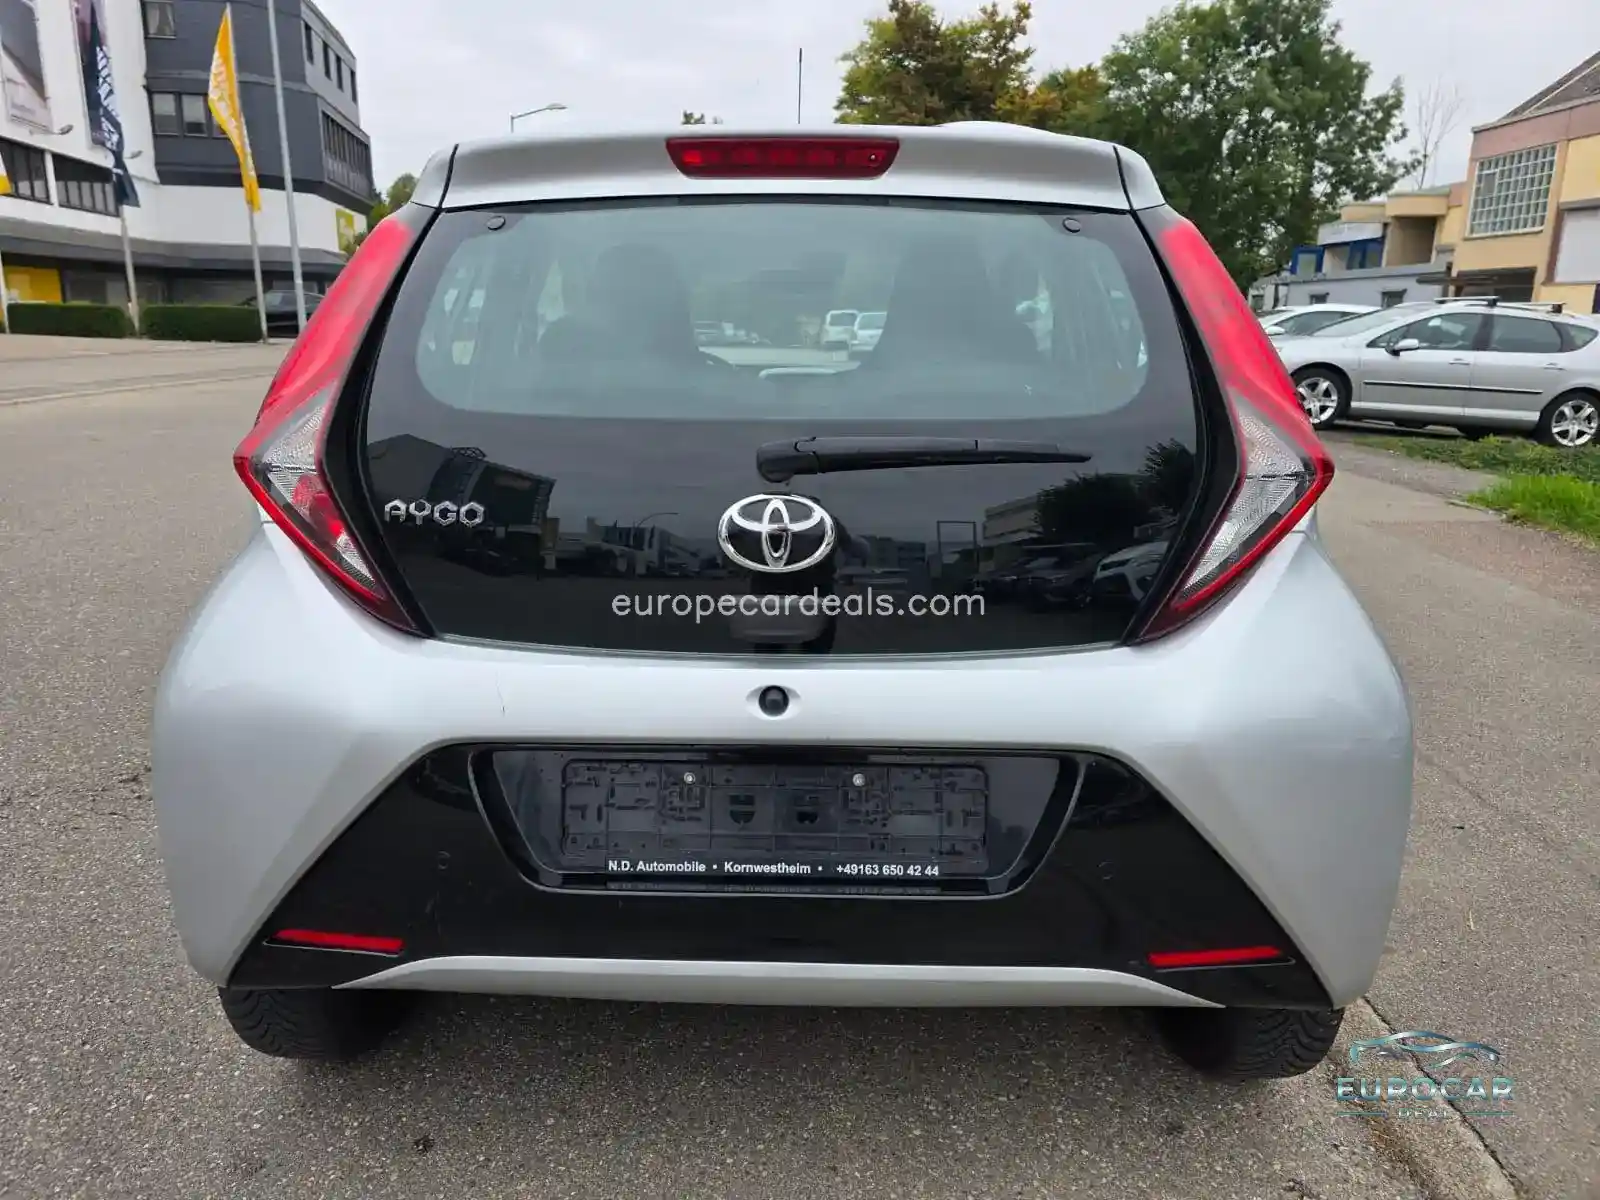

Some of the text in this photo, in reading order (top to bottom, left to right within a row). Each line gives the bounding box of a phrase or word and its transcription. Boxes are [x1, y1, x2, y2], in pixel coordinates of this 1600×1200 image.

[384, 498, 485, 527] AYGO
[608, 859, 940, 877] N.D. Automobile Kornwestheim +49163 650 42 44
